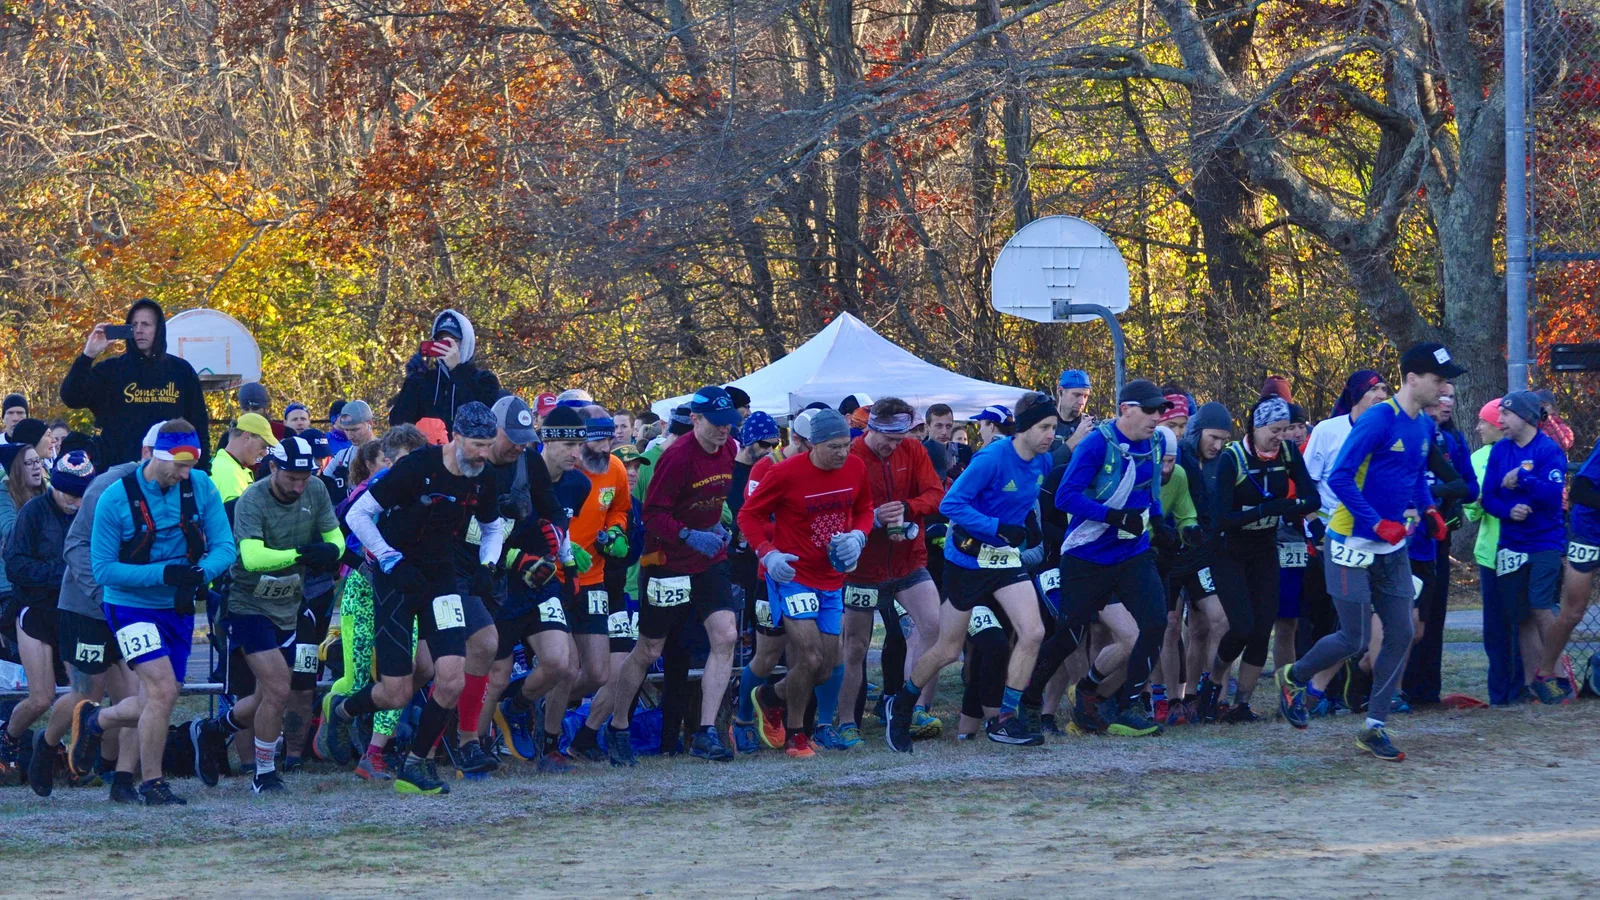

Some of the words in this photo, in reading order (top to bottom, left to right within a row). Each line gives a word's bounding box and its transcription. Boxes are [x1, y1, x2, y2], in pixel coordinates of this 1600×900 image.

[124, 382, 179, 403] Somerville
[692, 475, 721, 488] BOSTON
[989, 554, 1009, 565] 99
[1334, 545, 1367, 566] 217
[1569, 545, 1597, 561] 207
[1501, 554, 1522, 571] 137
[262, 585, 291, 597] 150
[655, 588, 684, 604] 125
[593, 600, 609, 614] 18
[790, 597, 818, 614] 118
[851, 593, 871, 607] 28
[454, 607, 463, 622] 5
[546, 606, 566, 621] 23
[973, 614, 993, 629] 34
[124, 633, 152, 656] 131
[79, 649, 101, 661] 42
[304, 655, 318, 670] 84
